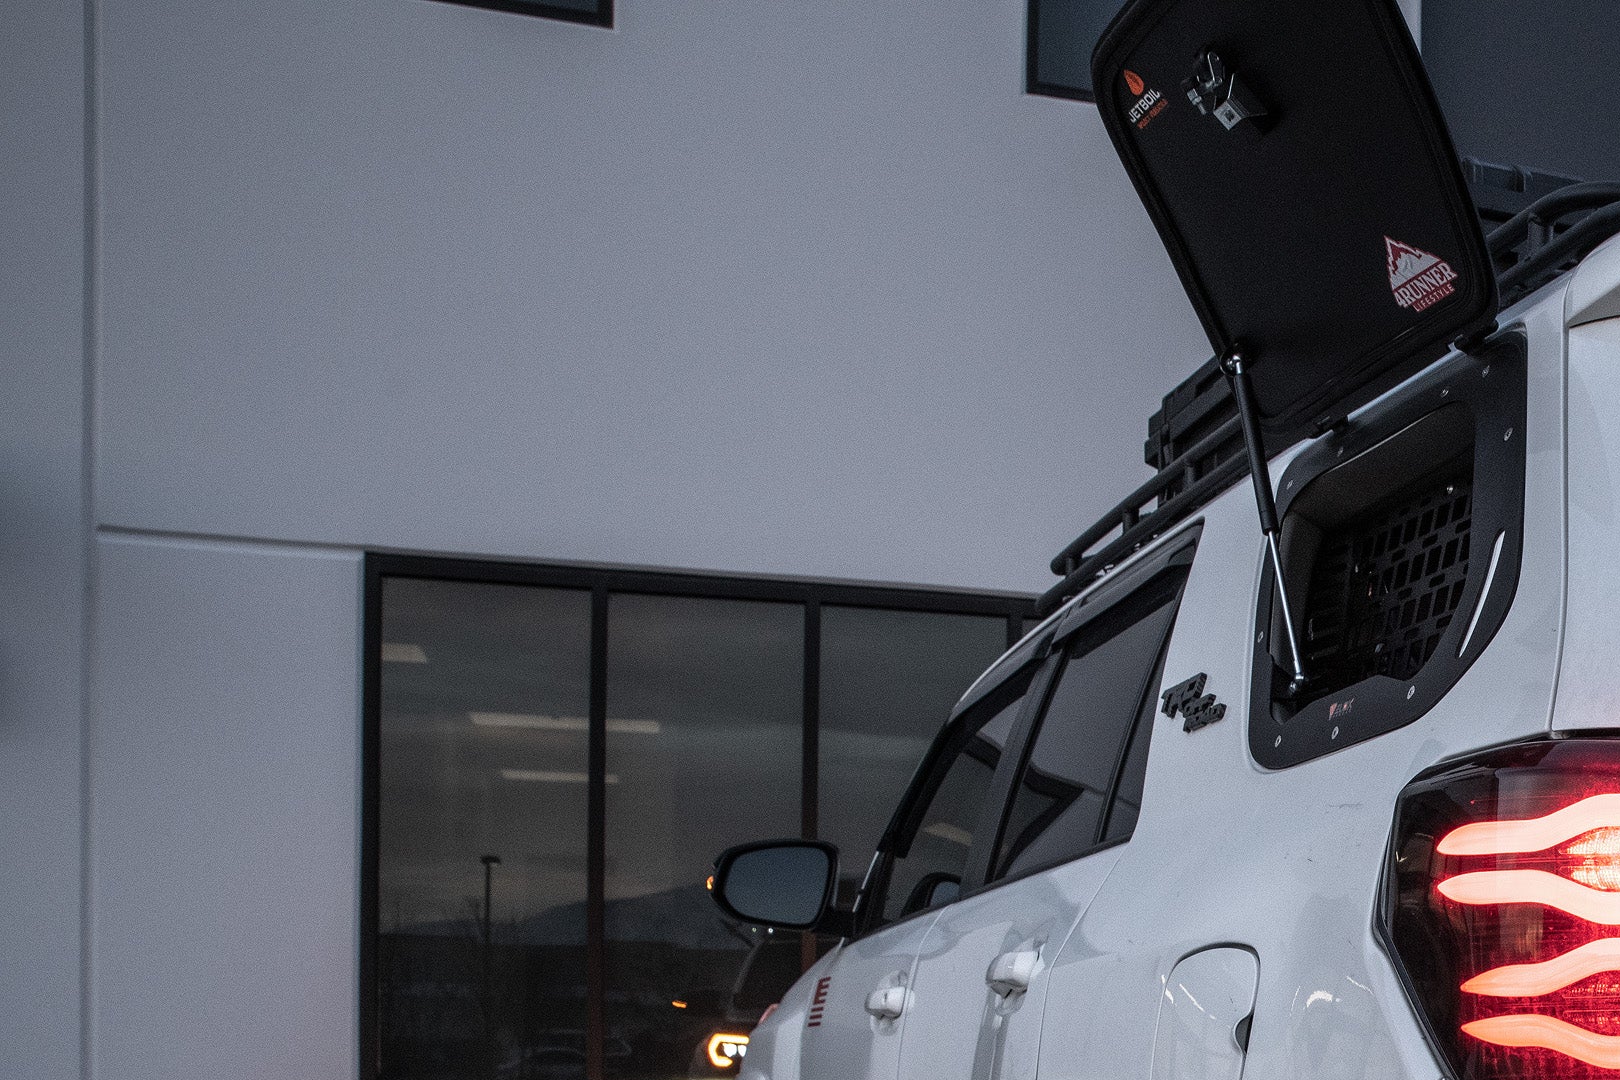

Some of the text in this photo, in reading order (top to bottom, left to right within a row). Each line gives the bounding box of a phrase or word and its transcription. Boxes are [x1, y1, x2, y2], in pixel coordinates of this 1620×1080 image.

[1128, 88, 1161, 123] JETBOIL
[1393, 262, 1459, 309] 4RUNNER
[1412, 283, 1456, 312] LIFESTYLE
